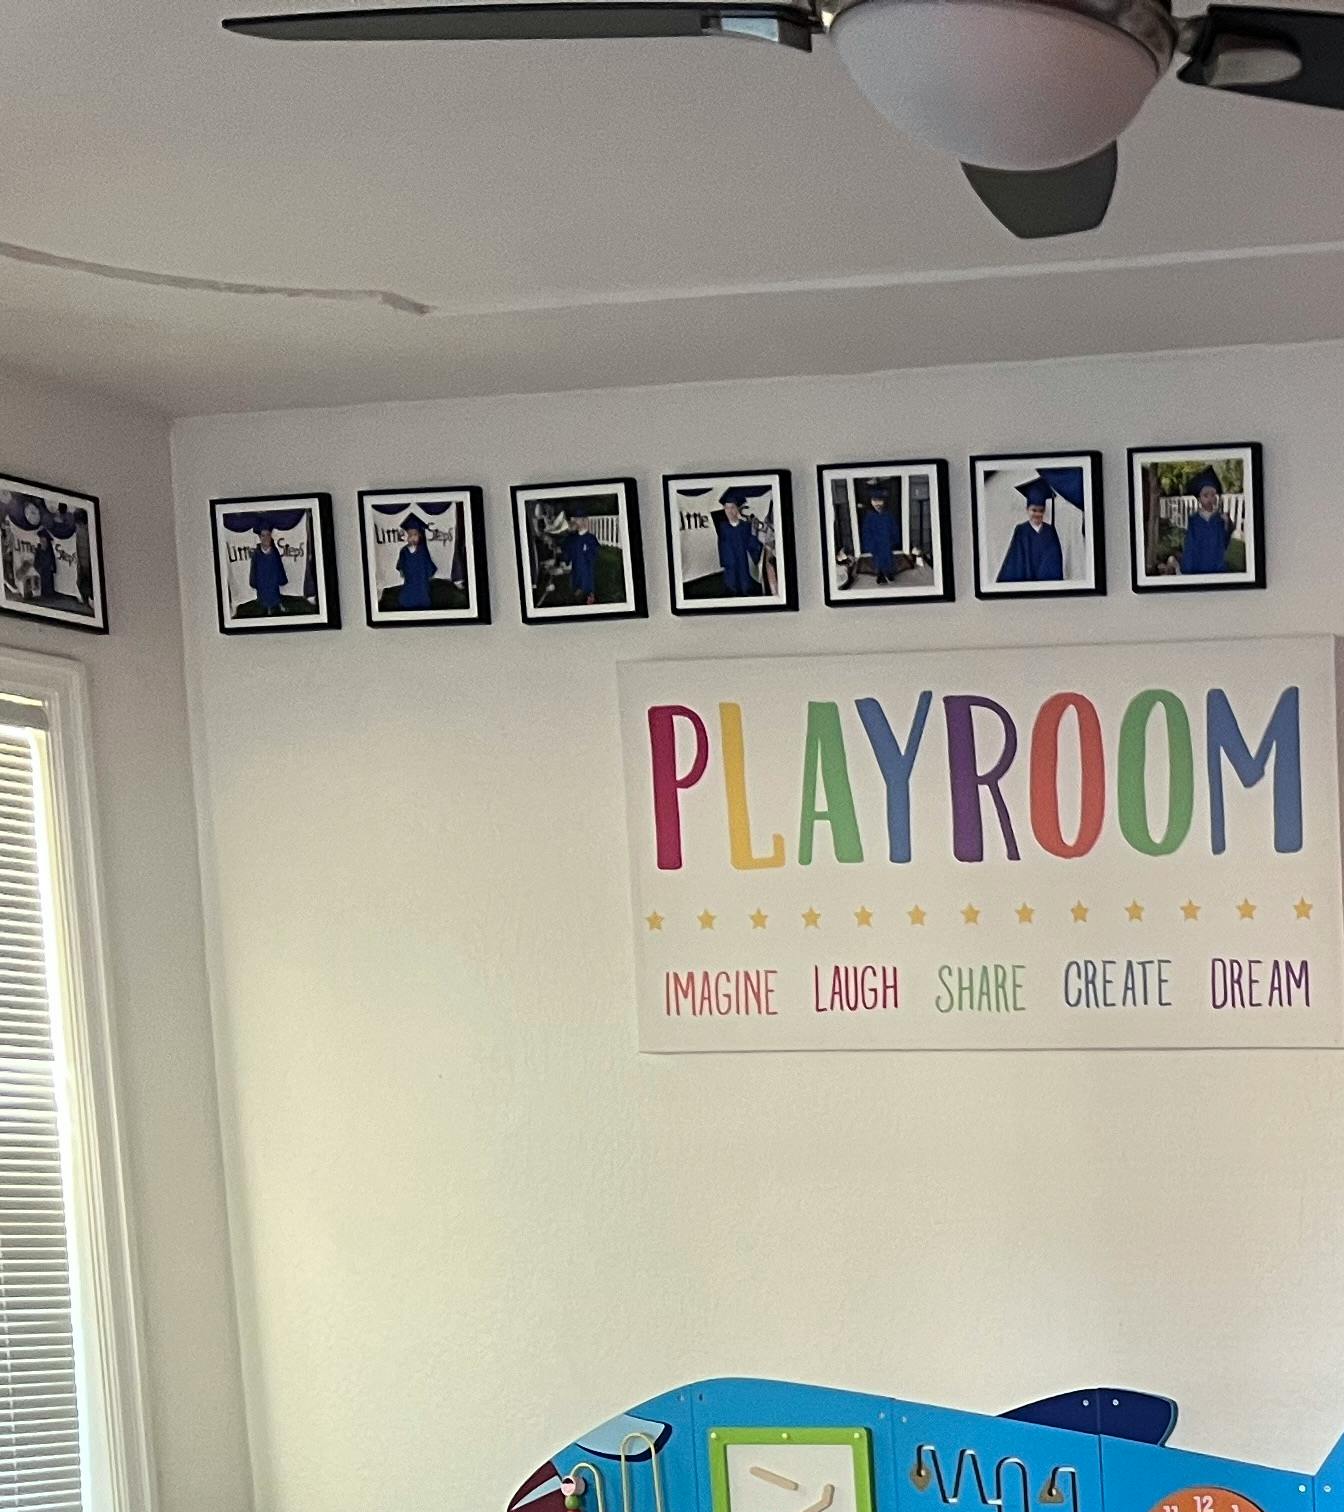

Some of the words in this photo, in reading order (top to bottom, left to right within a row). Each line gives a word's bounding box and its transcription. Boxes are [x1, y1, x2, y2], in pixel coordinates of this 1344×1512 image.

[647, 686, 1304, 870] PLAYROOM
[665, 969, 779, 1016] IMAGINE
[813, 964, 900, 1012] LAUGH
[935, 963, 1027, 1012] SHARE
[1063, 959, 1173, 1007] CREATE
[1210, 957, 1311, 1009] DREAM
[1193, 1495, 1214, 1512] 12
